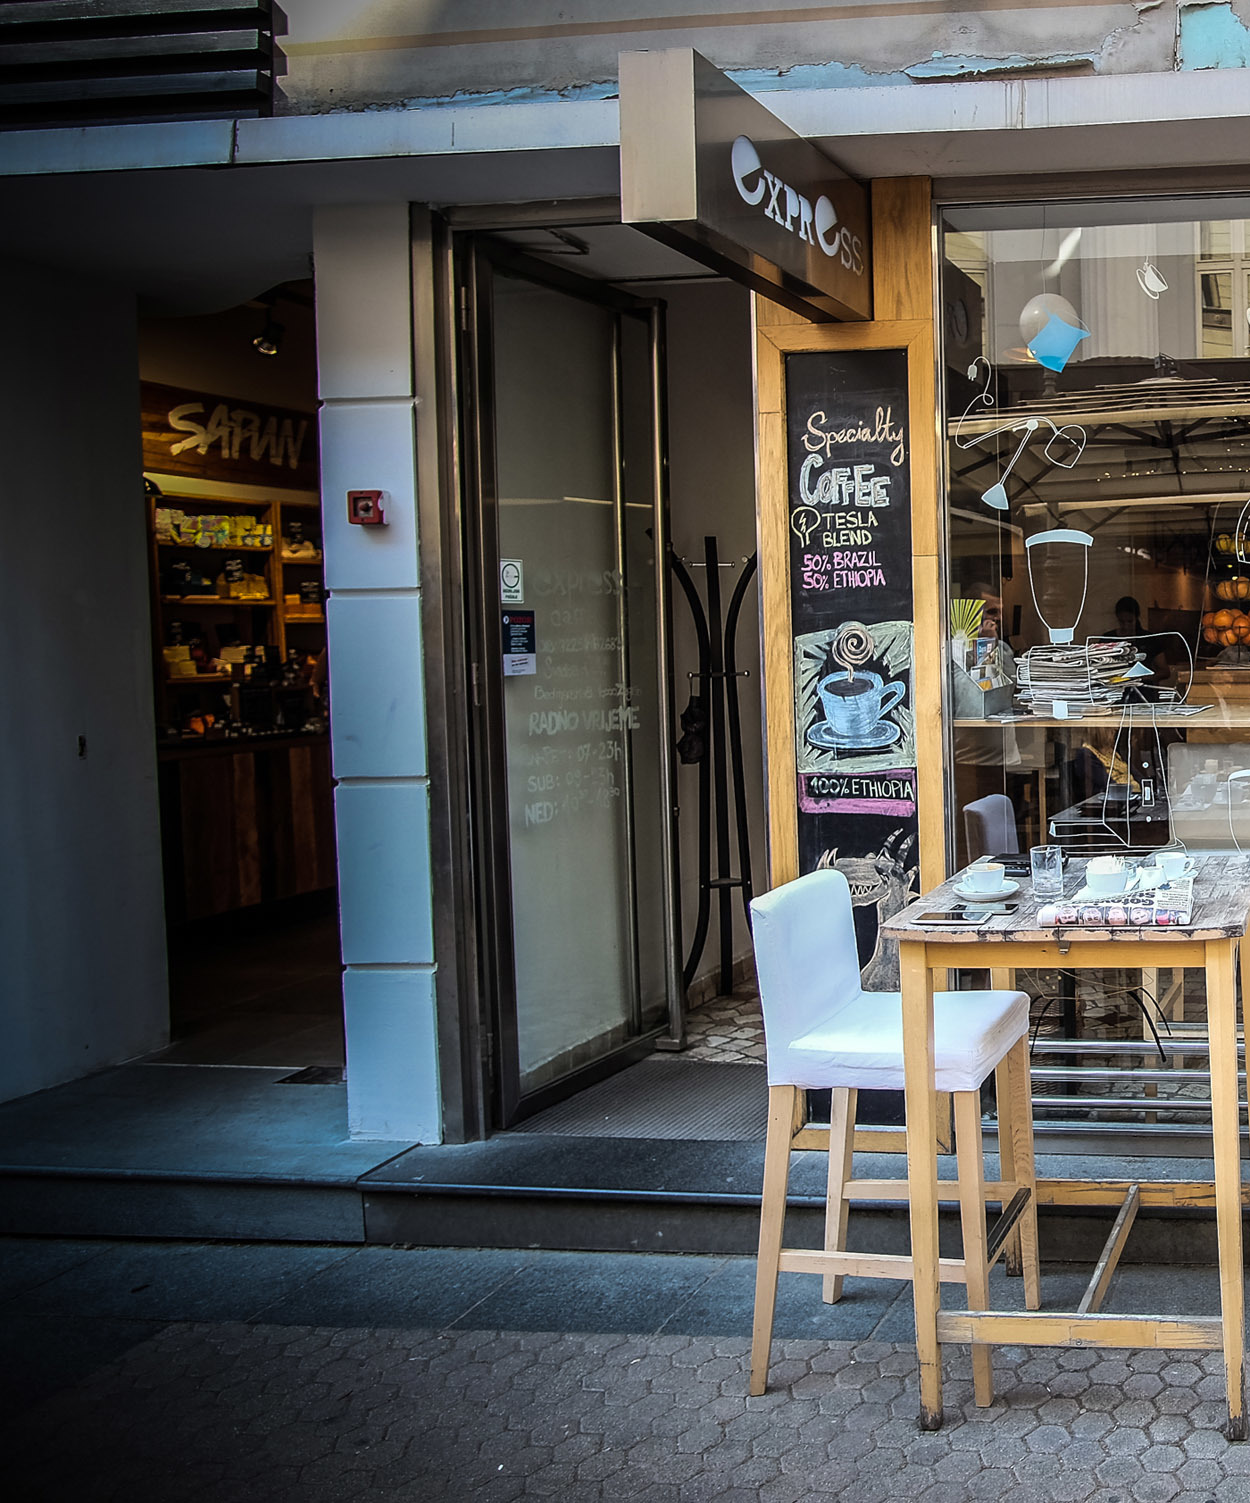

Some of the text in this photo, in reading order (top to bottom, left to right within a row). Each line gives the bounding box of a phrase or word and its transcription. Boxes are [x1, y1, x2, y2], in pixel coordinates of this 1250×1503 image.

[801, 406, 904, 467] Specialty
[822, 510, 878, 529] TESLA
[823, 530, 872, 548] BLEND
[801, 550, 882, 572] 50% BRAZIL
[802, 568, 886, 590] 50% ETHIOPIA
[529, 706, 640, 736] RADNO VRIJEME
[810, 776, 914, 802] 100% ETHIOPIA
